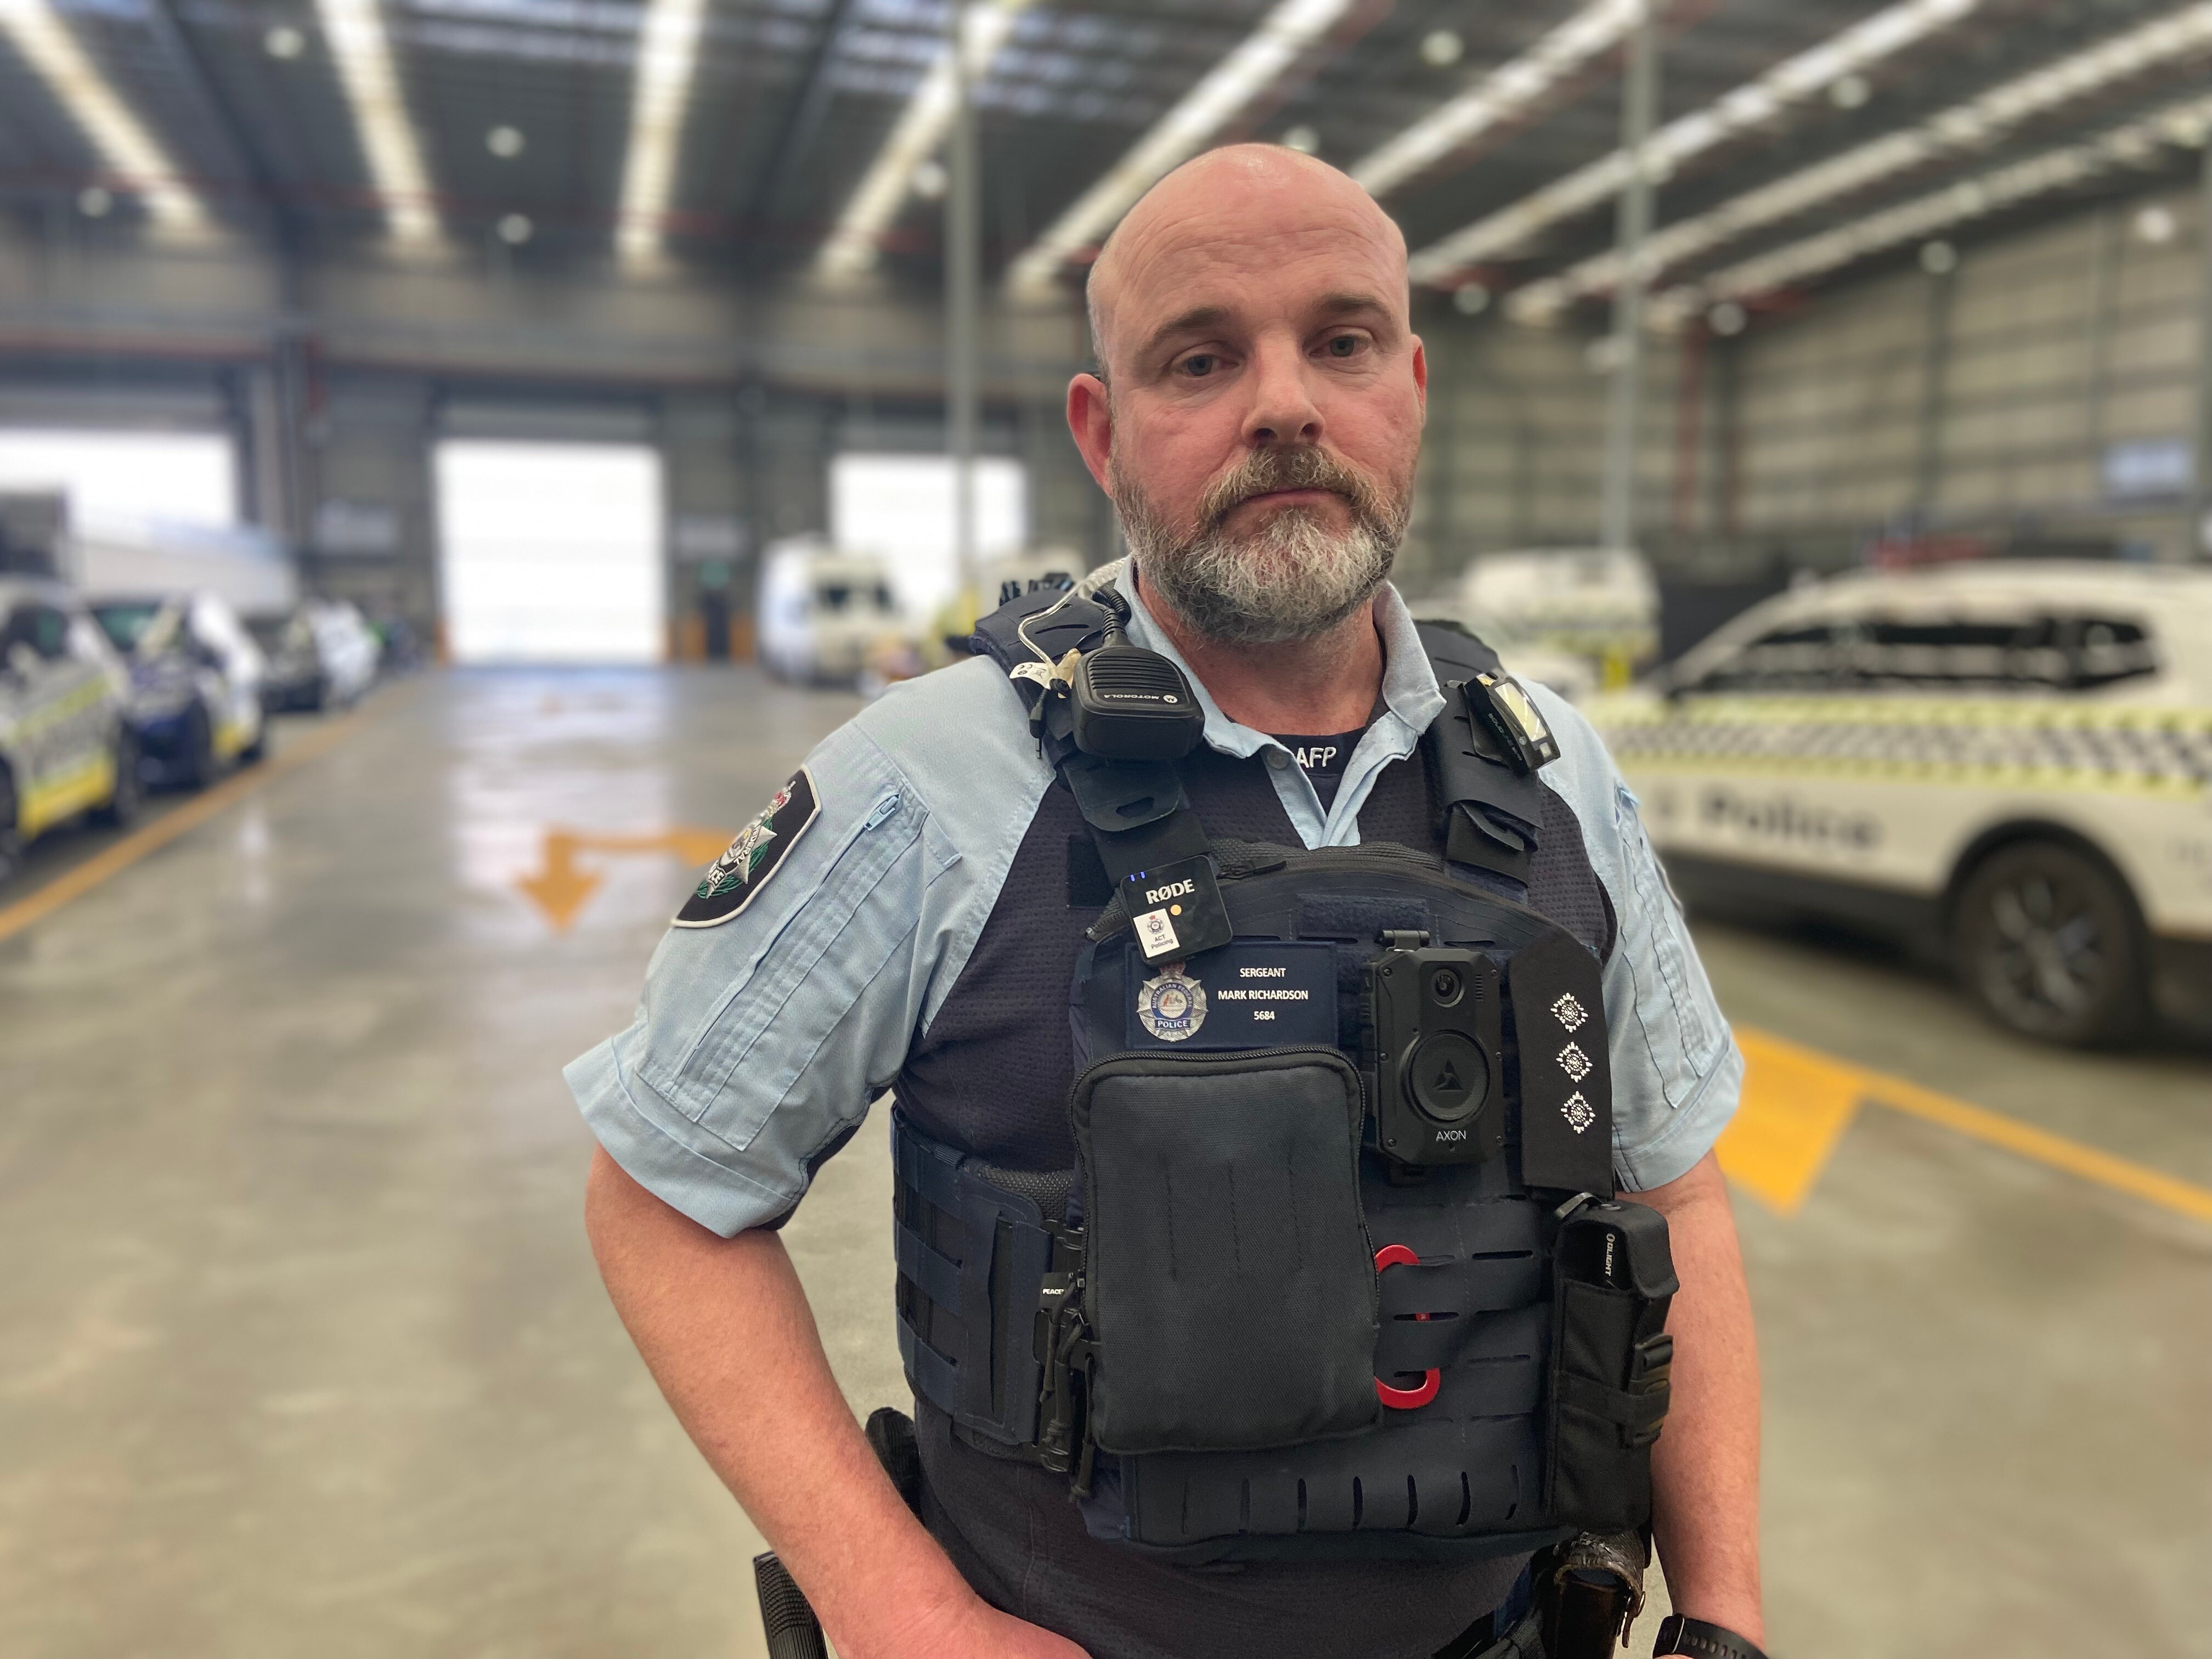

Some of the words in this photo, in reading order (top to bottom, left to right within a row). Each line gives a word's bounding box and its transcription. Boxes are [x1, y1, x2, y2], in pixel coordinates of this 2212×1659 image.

[1297, 747, 1336, 768] AFP
[1145, 879, 1195, 904] RØDE
[1151, 939, 1173, 949] Policing
[1240, 968, 1286, 977] SERGEANT
[1152, 984, 1177, 1009] AUSTRALIAN
[1218, 990, 1247, 1000] MARK
[1249, 990, 1308, 1000] RICHARDSON
[1254, 1011, 1275, 1020] 5684
[1158, 1020, 1188, 1029] POLICE
[1436, 1130, 1466, 1142] AXON
